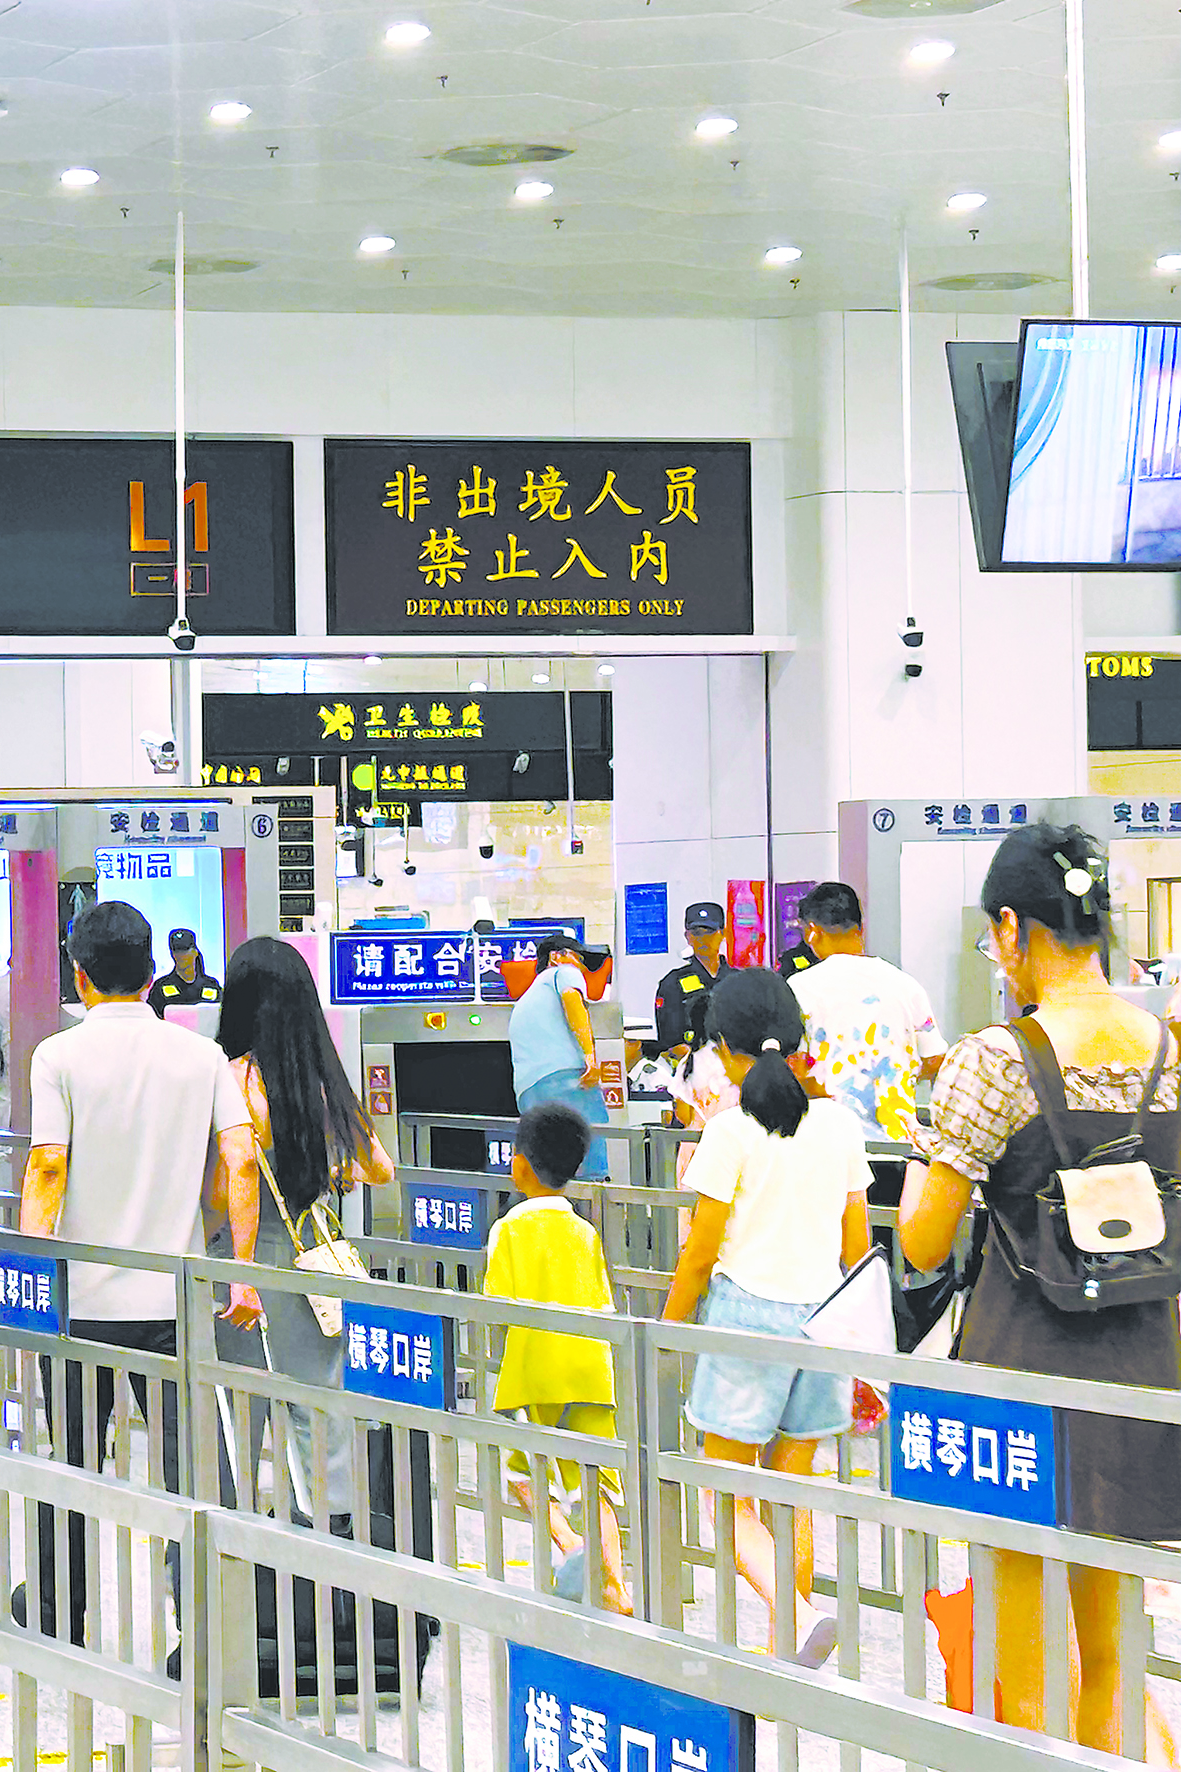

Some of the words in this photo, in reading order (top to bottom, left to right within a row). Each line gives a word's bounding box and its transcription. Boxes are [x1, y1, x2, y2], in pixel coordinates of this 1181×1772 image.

[129, 481, 209, 552] L1
[381, 464, 700, 525] 非出境人员
[418, 528, 671, 587] 禁止入内
[404, 599, 509, 616] DEPARTING
[516, 599, 631, 616] PASSENGERS
[638, 599, 686, 616] ONLY
[413, 1196, 474, 1234] 横琴口岸
[347, 1321, 434, 1384] 横琴口岸
[899, 1411, 1039, 1492] 横琴口岸
